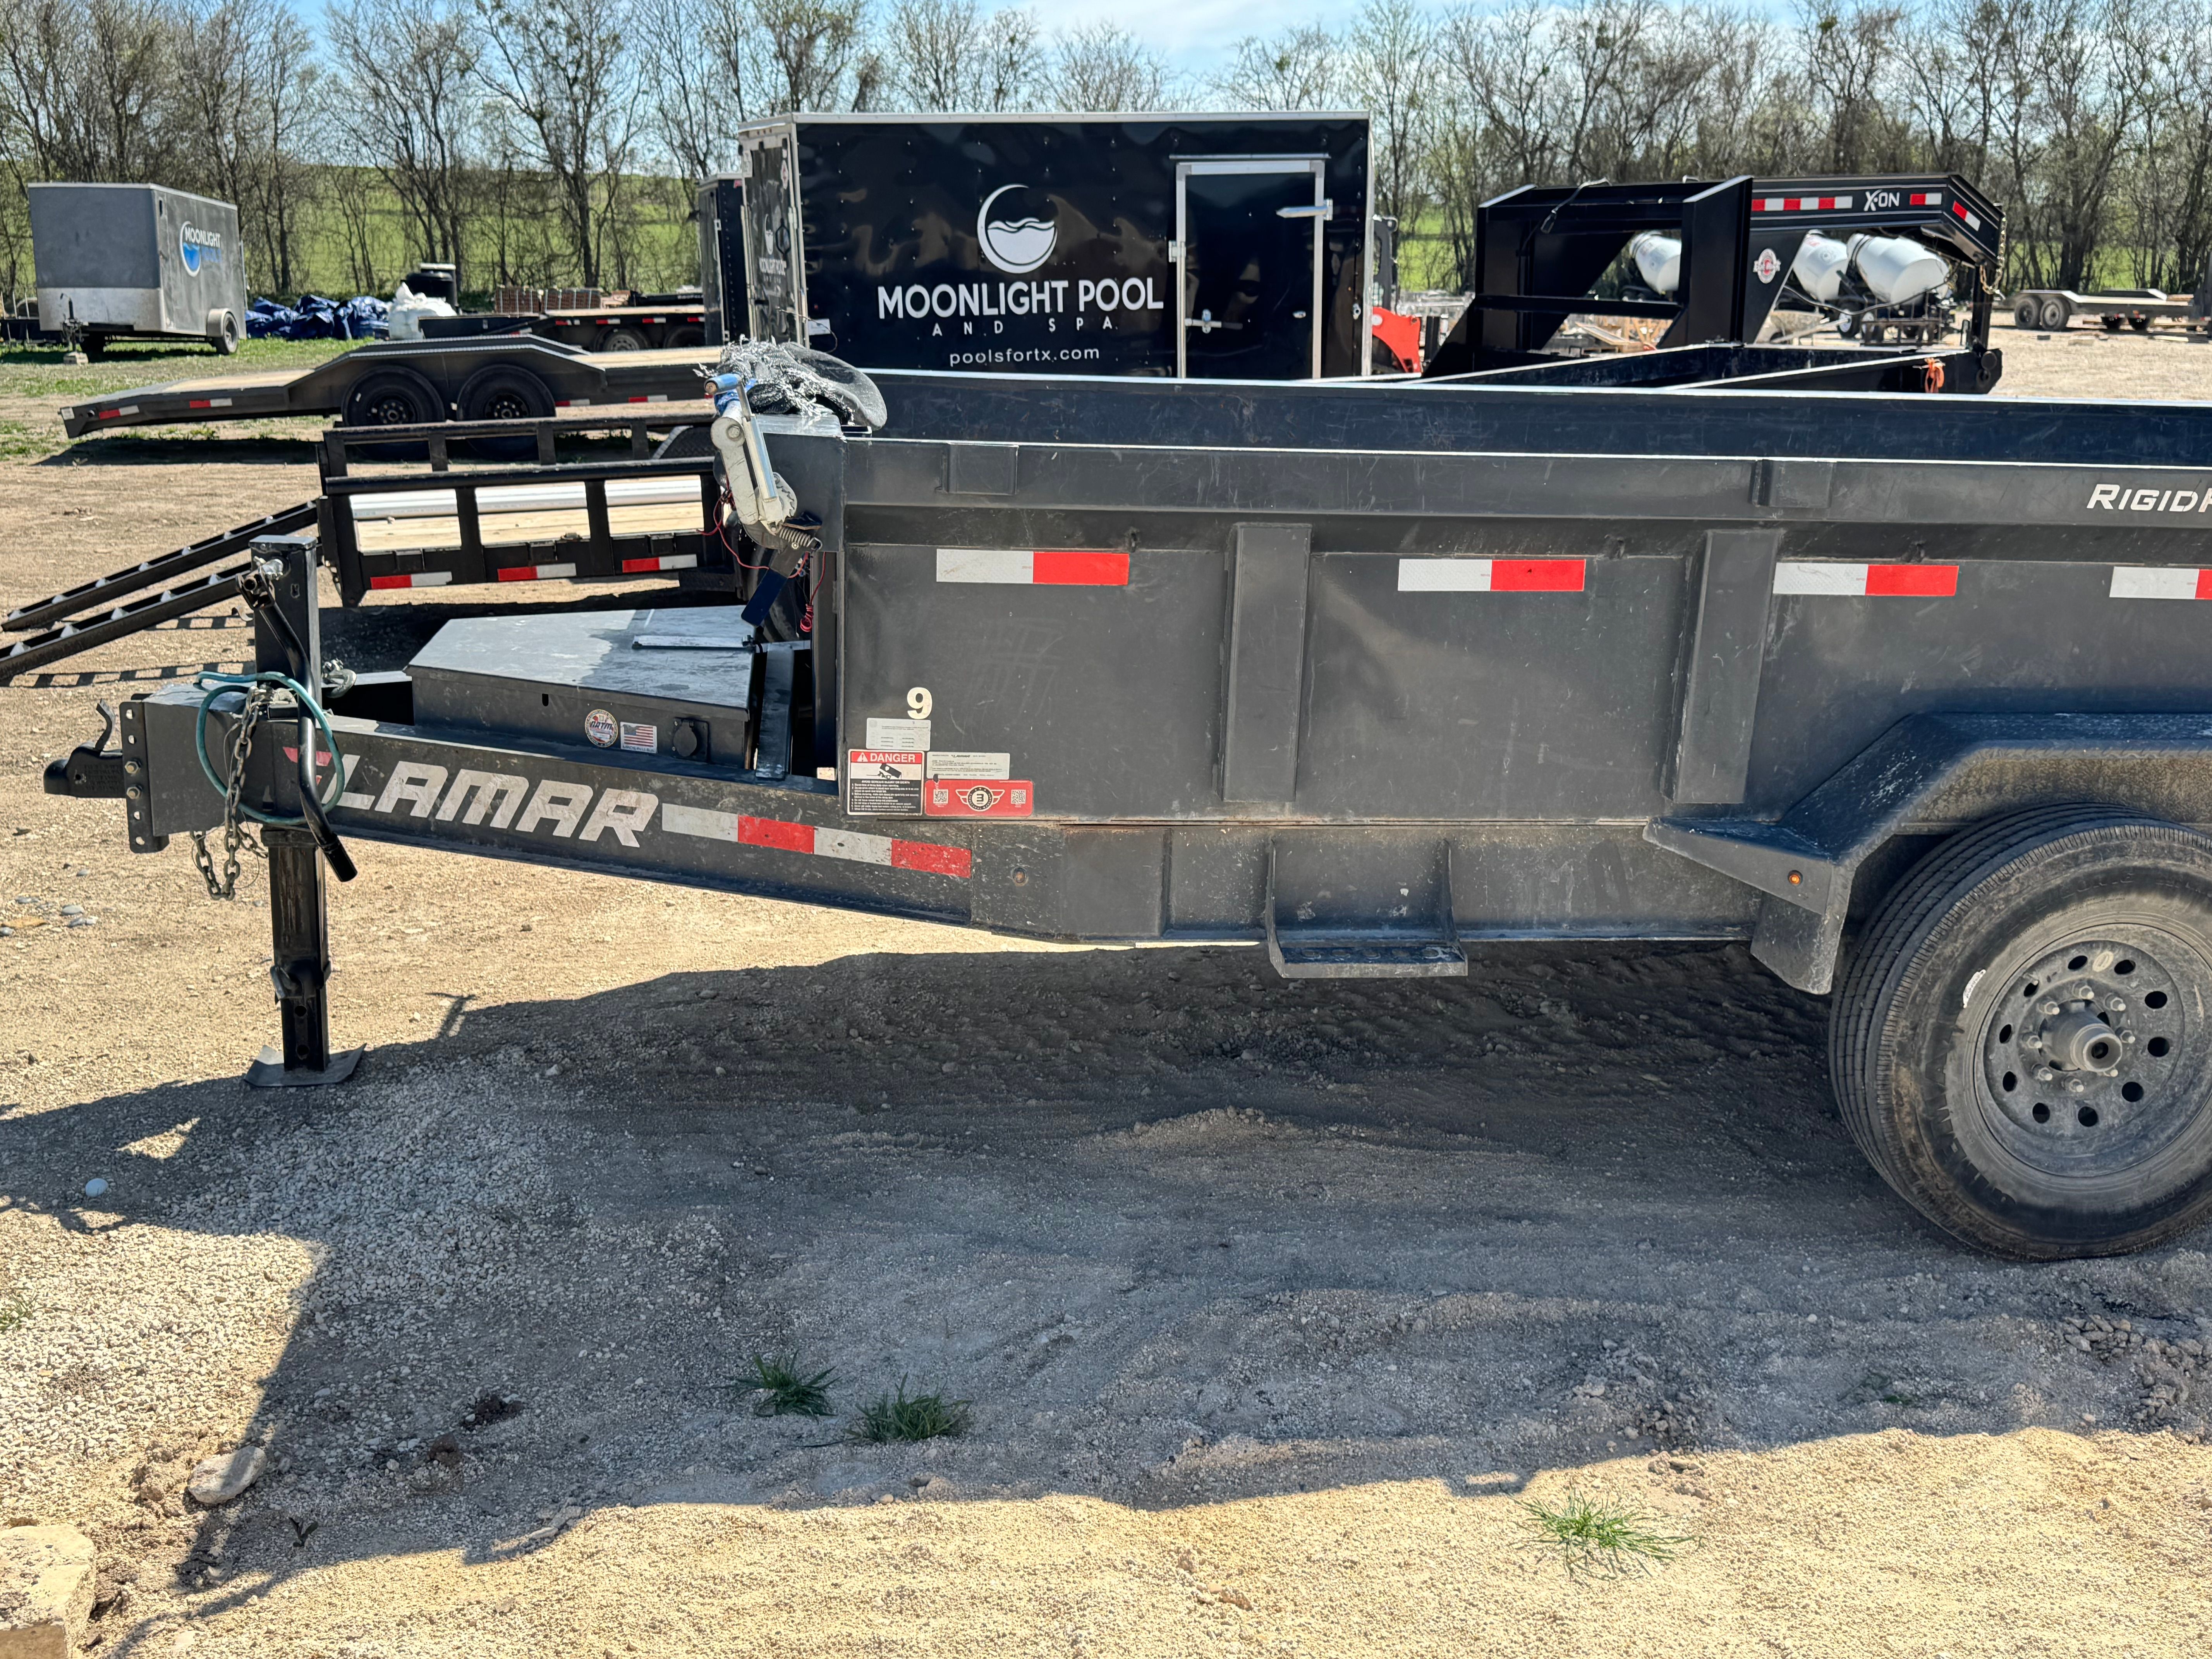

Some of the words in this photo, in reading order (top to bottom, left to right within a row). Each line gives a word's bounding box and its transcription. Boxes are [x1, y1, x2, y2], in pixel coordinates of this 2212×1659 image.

[185, 226, 221, 248] MOONLIGHT
[878, 280, 1068, 319] MOONLIGHT
[1079, 277, 1164, 311] POOL
[932, 320, 1003, 336] AND
[1049, 316, 1112, 332] SPA
[950, 348, 1099, 367] poolsfortx.com
[907, 687, 932, 719] 9
[870, 753, 915, 763] DANGER
[321, 754, 659, 848] LAMAR
